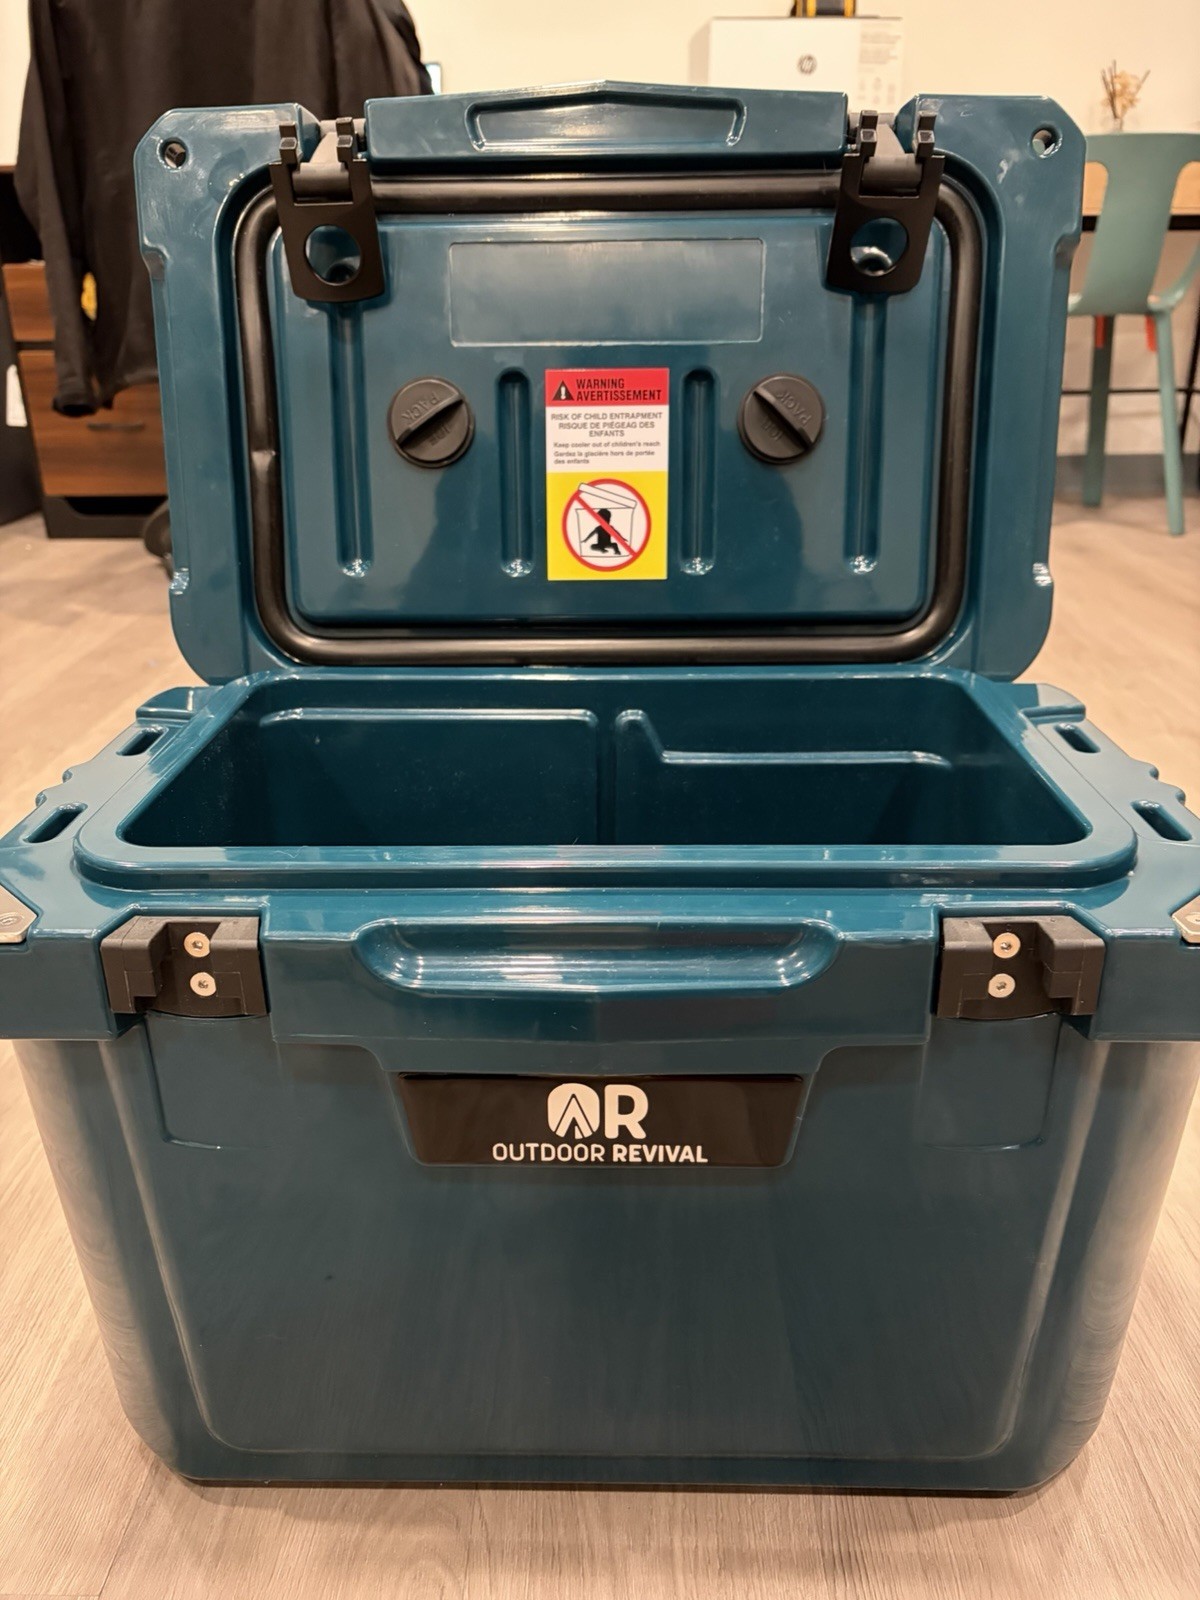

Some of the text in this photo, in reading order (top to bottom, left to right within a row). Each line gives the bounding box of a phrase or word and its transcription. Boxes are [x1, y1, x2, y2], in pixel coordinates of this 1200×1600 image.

[576, 378, 625, 390] WARNING
[576, 390, 662, 402] AVERTISSEMENT
[609, 412, 663, 420] ENTRAPMENT
[558, 422, 588, 430] RISQUE
[639, 421, 655, 429] DES
[492, 1143, 709, 1163] OUTDOOR REVIVAL
